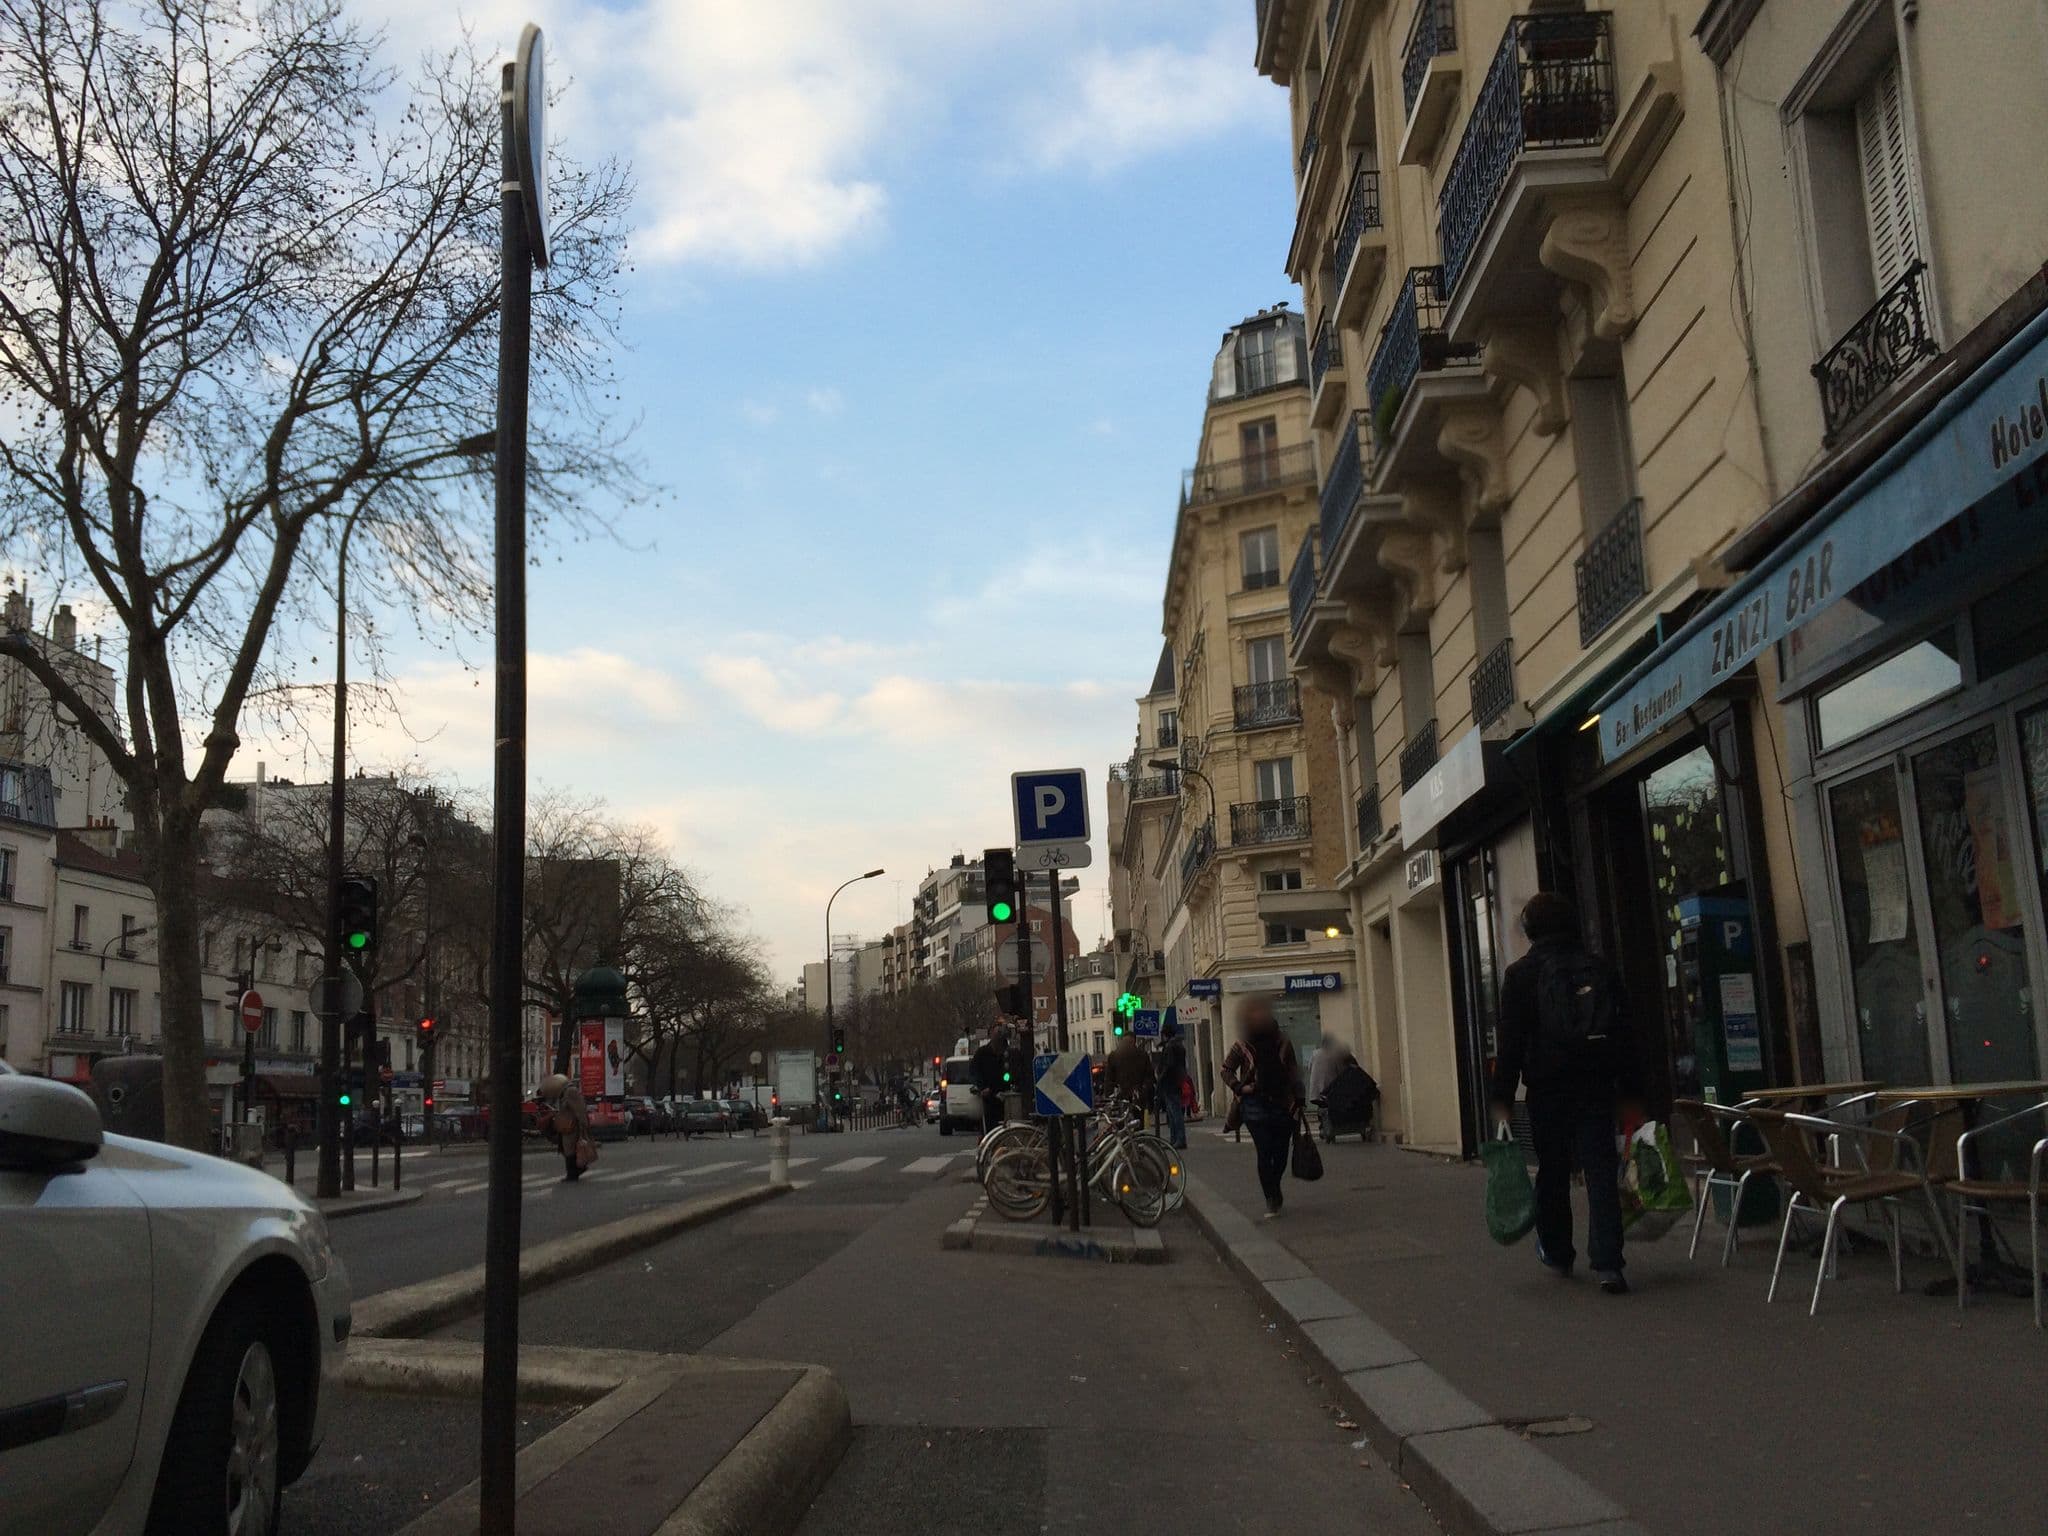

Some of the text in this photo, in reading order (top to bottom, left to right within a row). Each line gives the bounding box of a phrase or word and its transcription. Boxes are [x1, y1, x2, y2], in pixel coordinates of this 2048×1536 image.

[1711, 591, 1769, 676] ZANZI
[1784, 541, 1833, 623] BAR
[1034, 785, 1066, 829] P
[1723, 920, 1743, 950] P
[1290, 977, 1322, 989] Allianz
